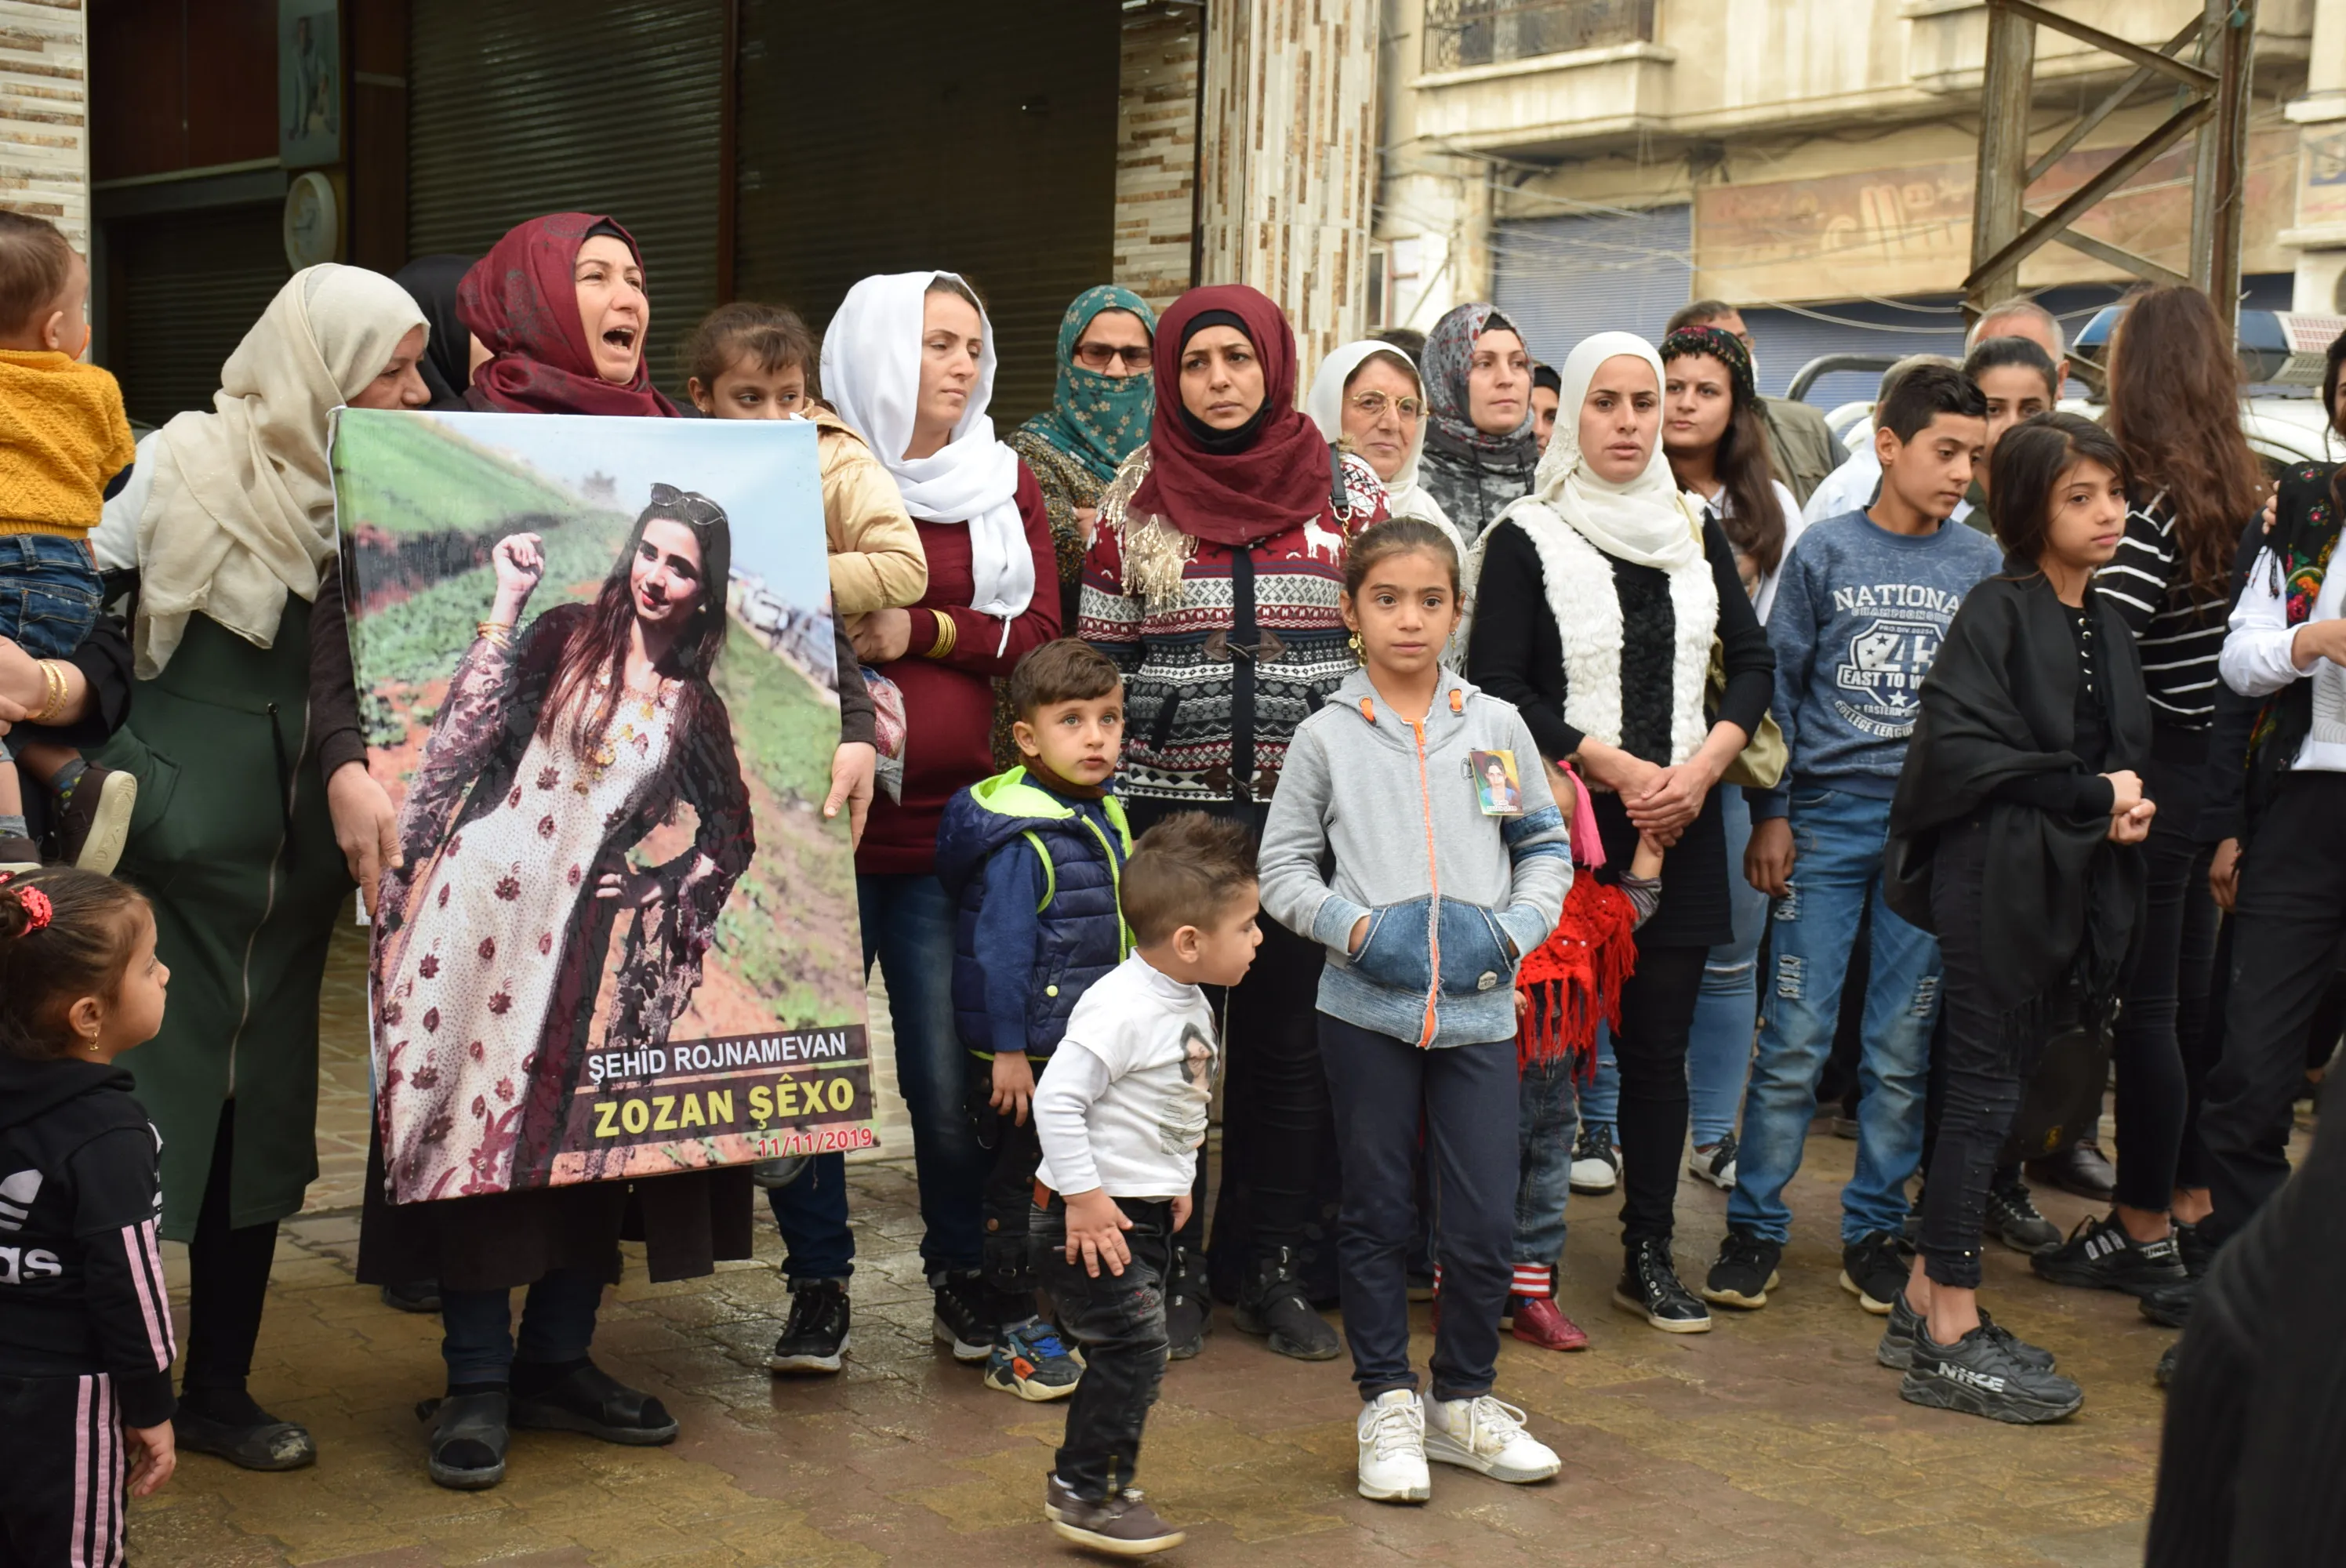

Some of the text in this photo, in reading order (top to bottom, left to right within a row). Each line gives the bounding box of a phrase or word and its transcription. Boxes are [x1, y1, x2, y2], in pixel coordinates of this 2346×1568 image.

[1832, 584, 1959, 616] NATIONA
[1843, 669, 1882, 687] EAST
[1886, 672, 1905, 688] TO
[1835, 700, 1873, 733] COLLEGE
[588, 1032, 847, 1085] ŞEHÎD ROJNAMEVAN
[594, 1073, 855, 1138] ZOZAN ŞÊXO
[757, 1127, 873, 1158] 11/11/2019
